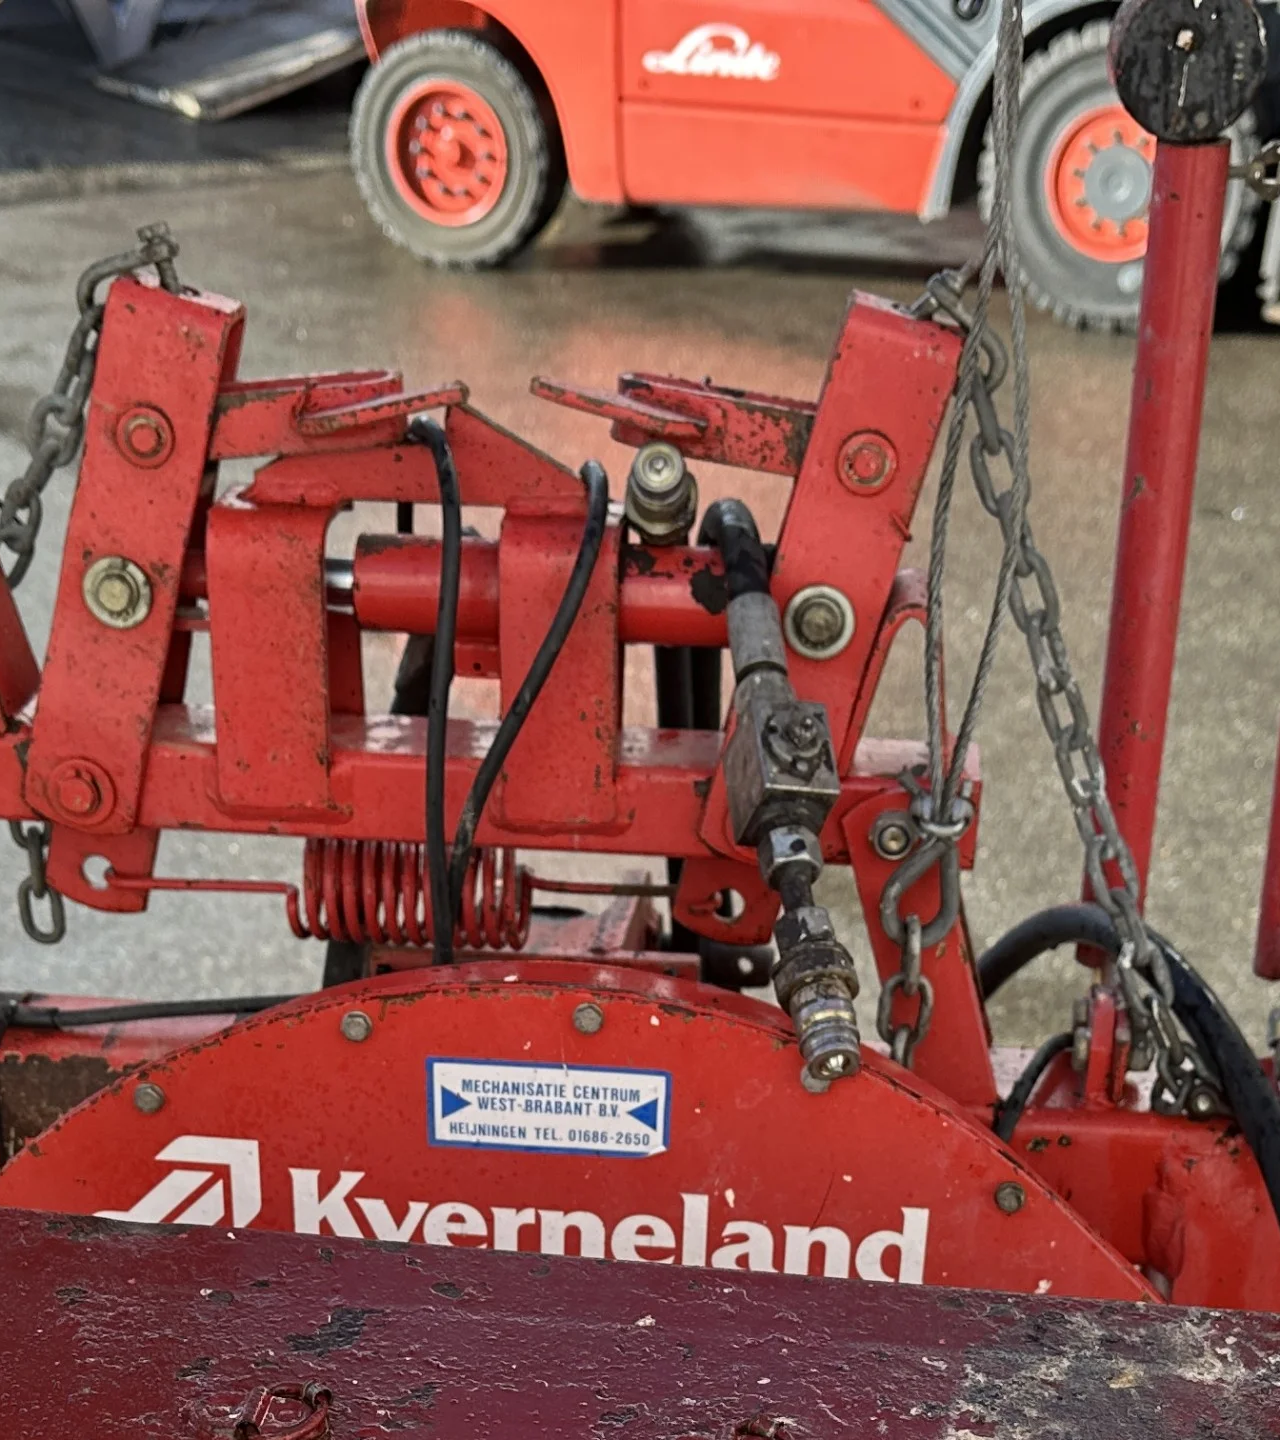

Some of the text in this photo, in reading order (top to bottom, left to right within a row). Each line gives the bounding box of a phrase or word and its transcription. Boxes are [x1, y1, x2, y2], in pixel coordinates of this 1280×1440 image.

[461, 1079, 641, 1103] MECHANISATIE CENTRUM
[477, 1096, 621, 1118] WEST-BRABANT B.V.
[449, 1121, 651, 1146] HEIJNINGEN TEL. 01686-2650
[291, 1167, 929, 1285] Kverneland
